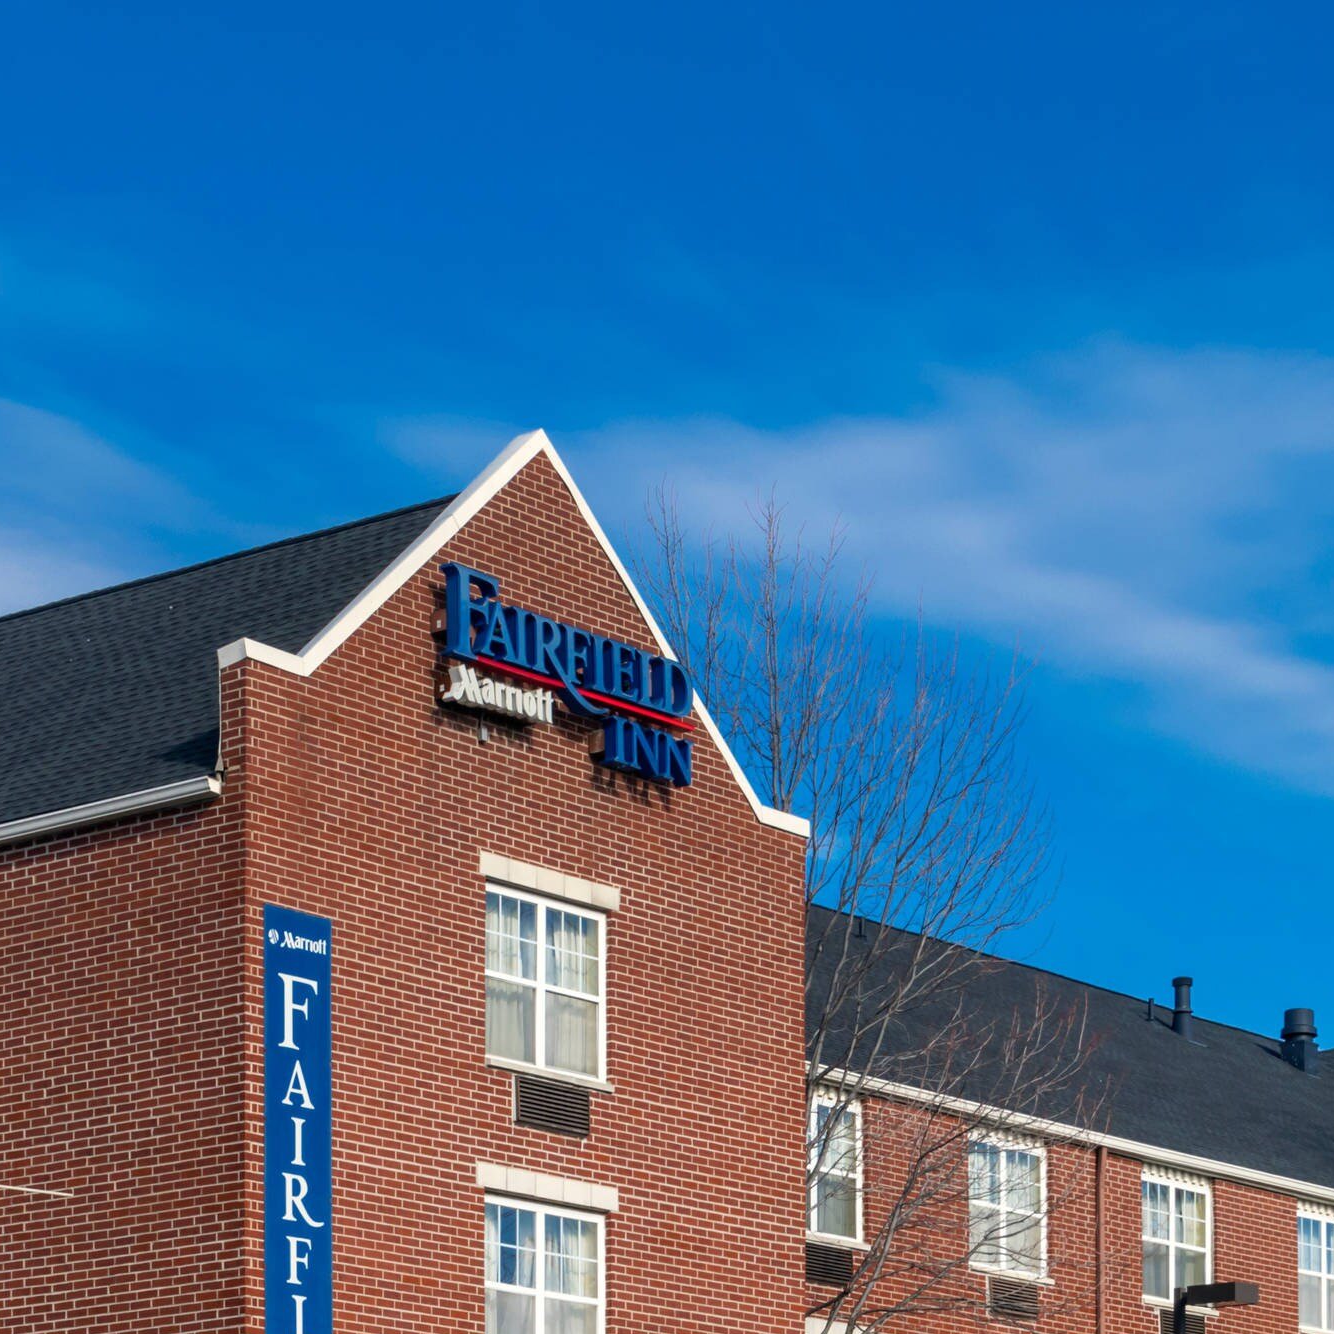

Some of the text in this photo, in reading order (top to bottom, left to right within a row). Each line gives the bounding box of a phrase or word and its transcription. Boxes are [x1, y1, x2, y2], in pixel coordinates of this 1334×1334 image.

[440, 562, 694, 716] FAIRFIELD
[442, 664, 554, 724] Marriott
[600, 715, 694, 787] INN
[280, 930, 327, 956] Marriott
